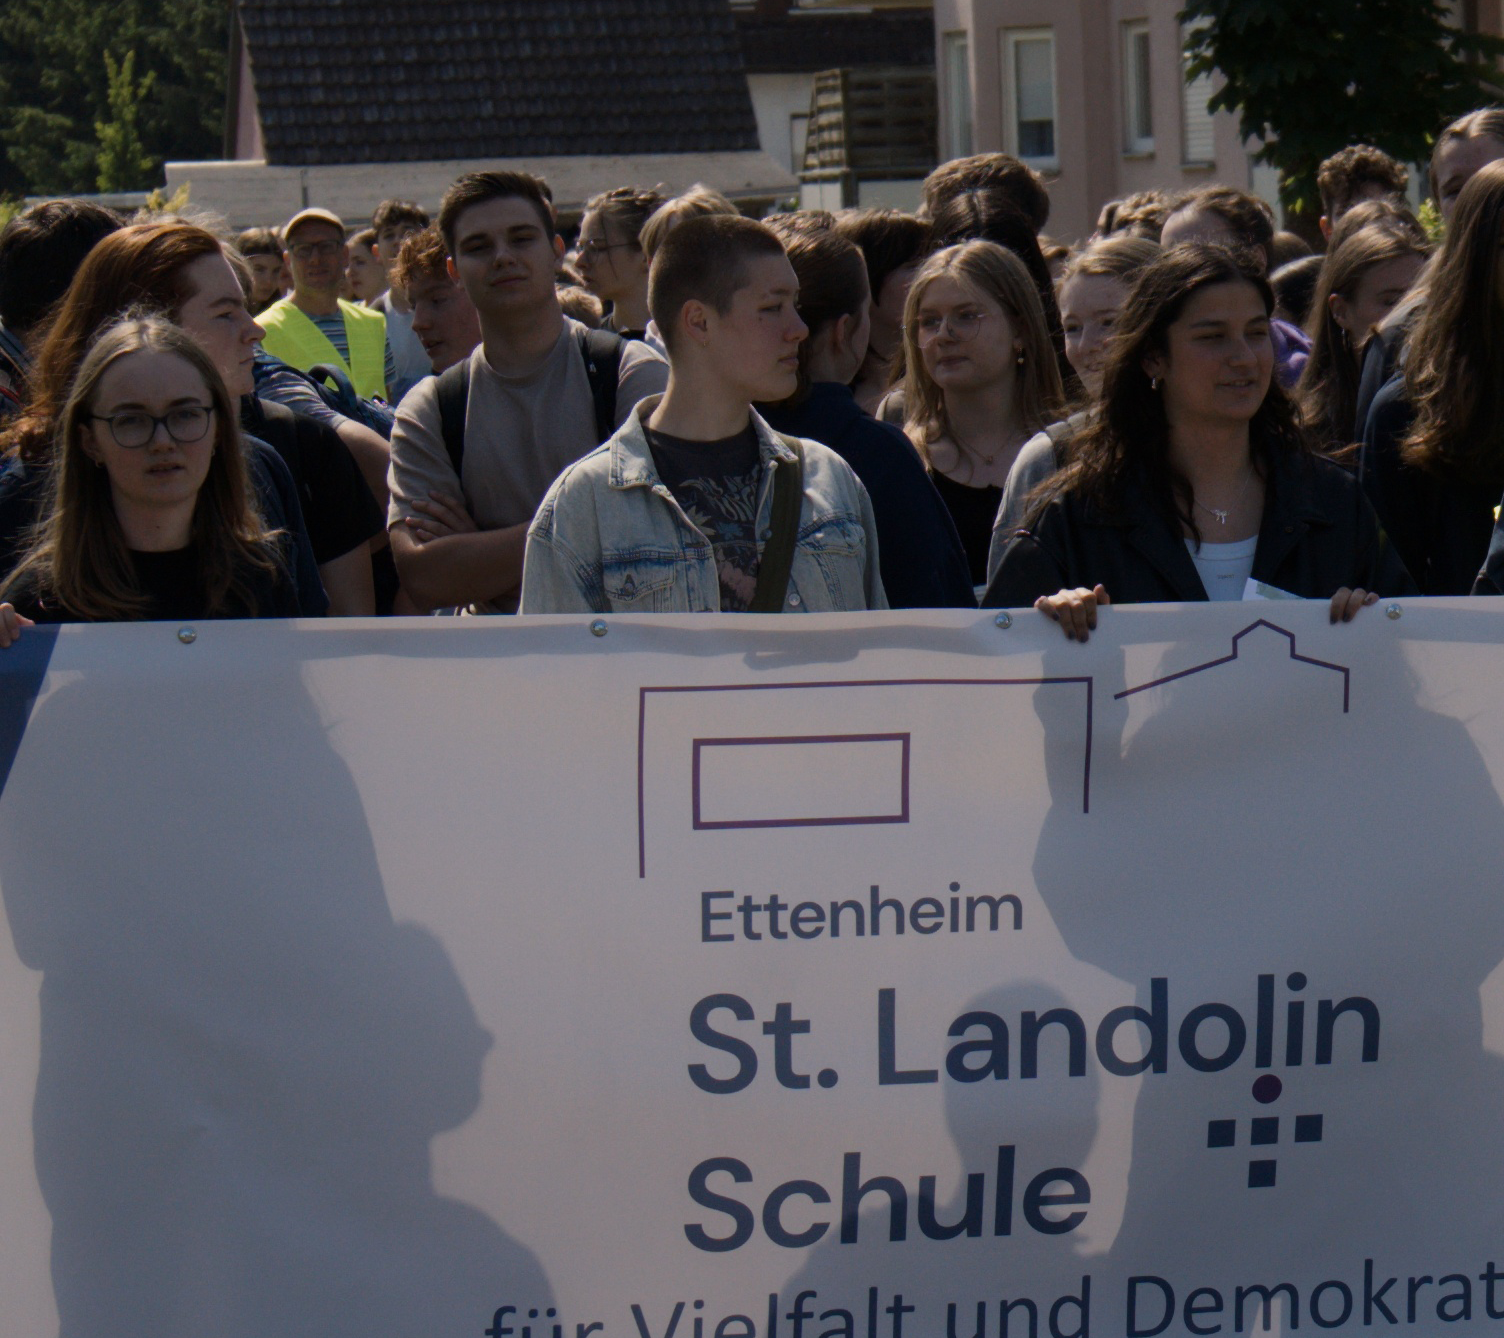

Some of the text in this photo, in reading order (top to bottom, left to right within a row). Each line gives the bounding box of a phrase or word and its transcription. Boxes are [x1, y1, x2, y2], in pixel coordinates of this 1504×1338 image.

[701, 881, 1023, 942] Ettenheim
[687, 971, 1381, 1094] St. Landolin
[683, 1145, 1091, 1253] Schule
